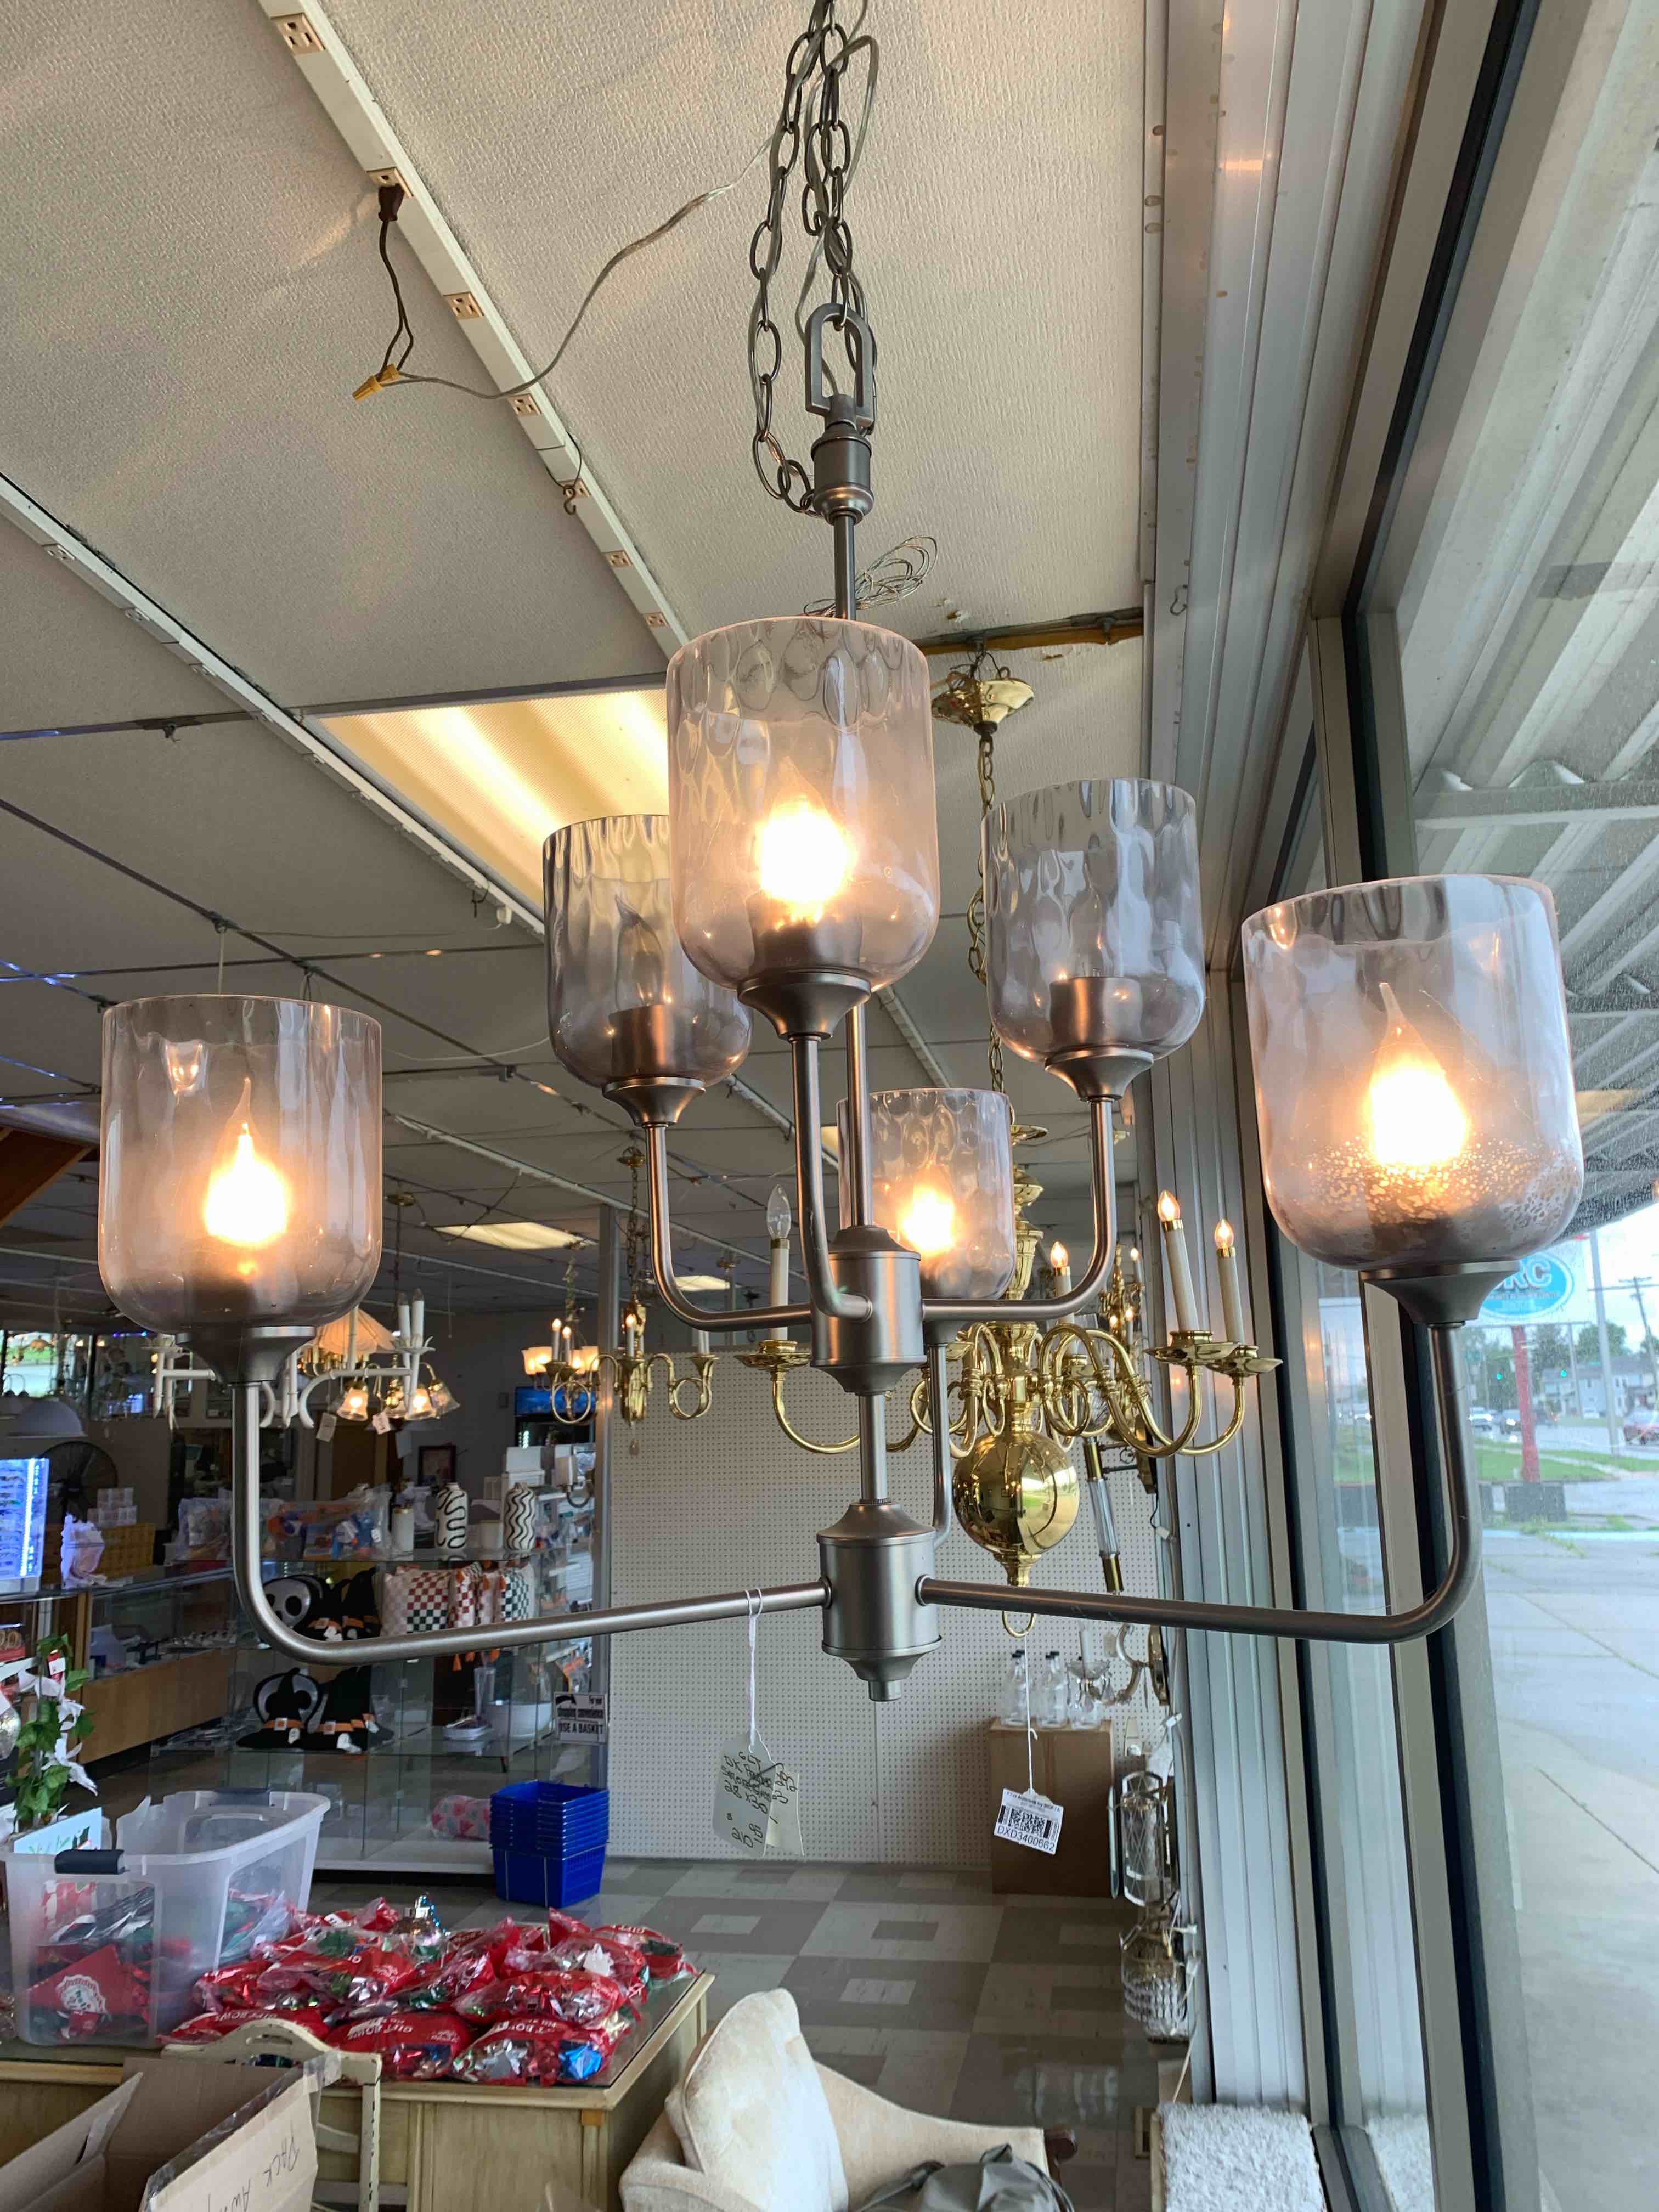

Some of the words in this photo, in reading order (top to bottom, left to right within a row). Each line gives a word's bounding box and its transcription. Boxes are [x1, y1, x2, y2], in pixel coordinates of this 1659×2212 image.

[572, 1722, 577, 1733] A
[579, 1723, 603, 1734] BASKET
[997, 1825, 1055, 1852] DXD3400662
[263, 2120, 300, 2187] PACK
